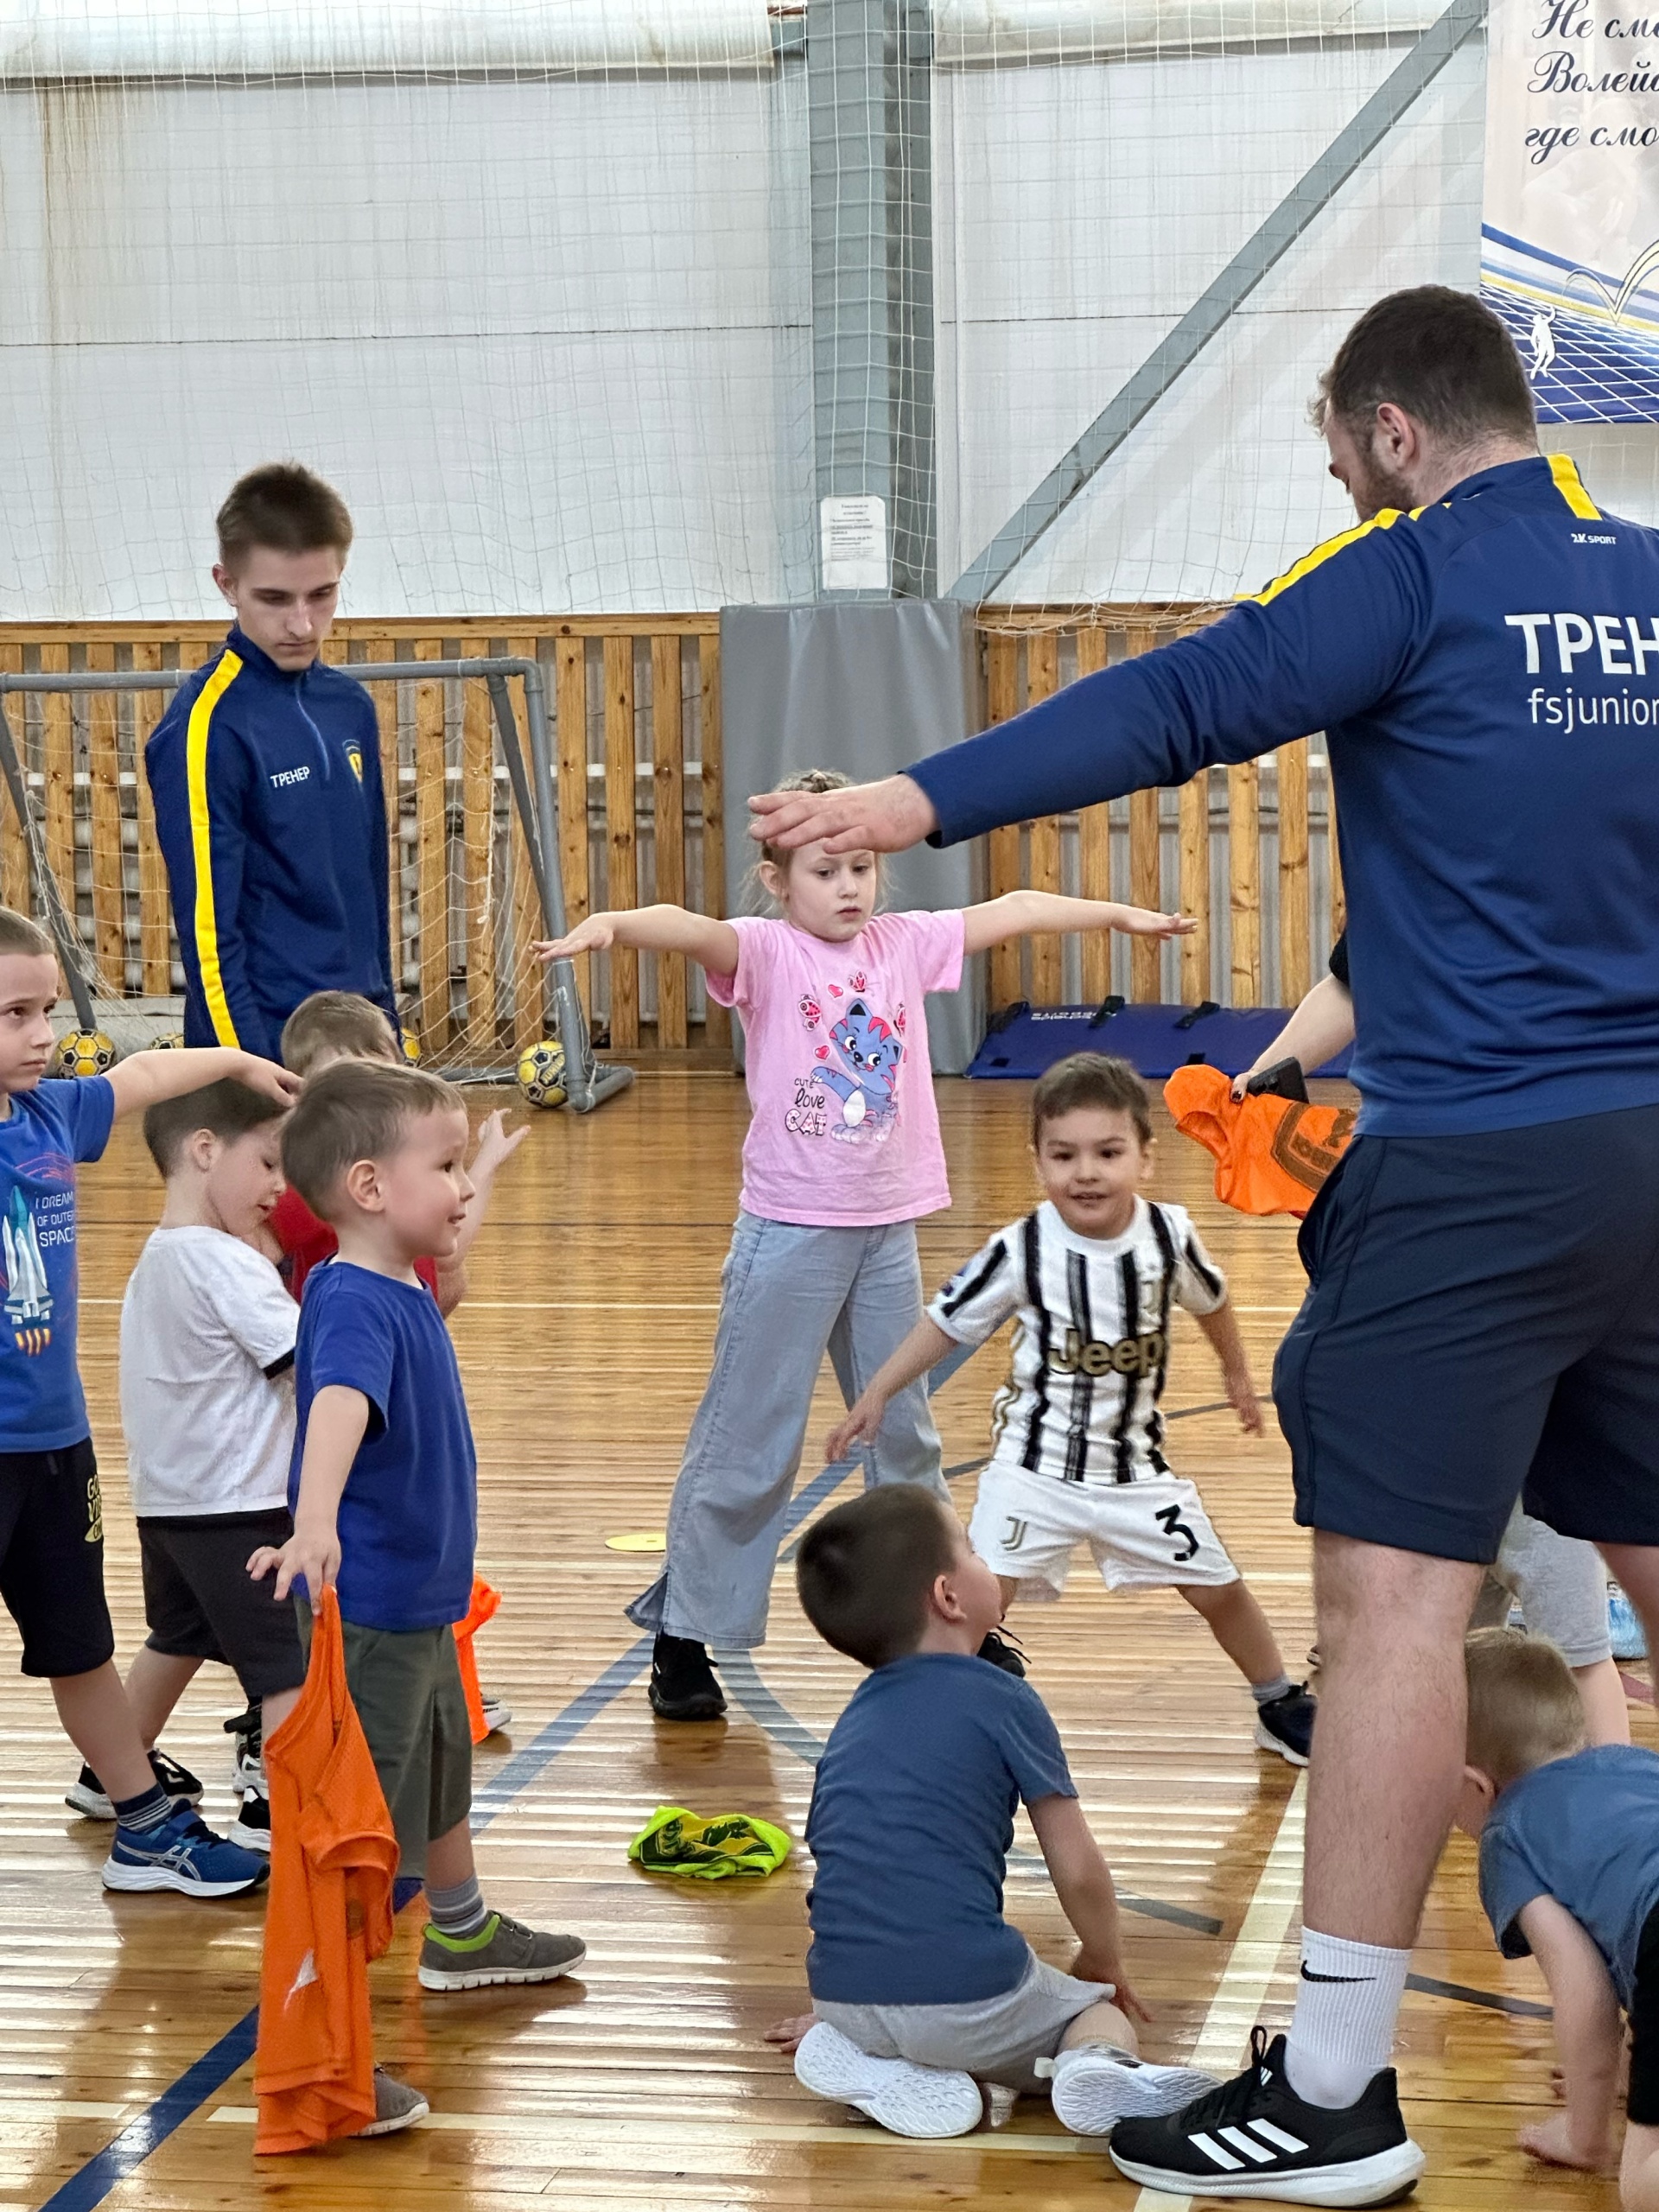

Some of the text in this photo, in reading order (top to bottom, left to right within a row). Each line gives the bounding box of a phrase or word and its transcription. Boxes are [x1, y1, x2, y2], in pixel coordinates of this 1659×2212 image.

[1532, 0, 1594, 39] Не
[1524, 127, 1580, 165] где
[1587, 535, 1617, 544] SPORT
[1504, 613, 1659, 676] ТРЕН
[1527, 688, 1659, 734] fsjunior
[270, 766, 311, 788] ТРЕНЕР
[794, 1077, 814, 1089] CUTE
[794, 1087, 825, 1109] love
[785, 1109, 827, 1136] CAT
[37, 1215, 48, 1227] OF
[39, 1226, 75, 1247] SPAC
[1046, 1328, 1166, 1378] Jeep
[1155, 1504, 1198, 1561] 3
